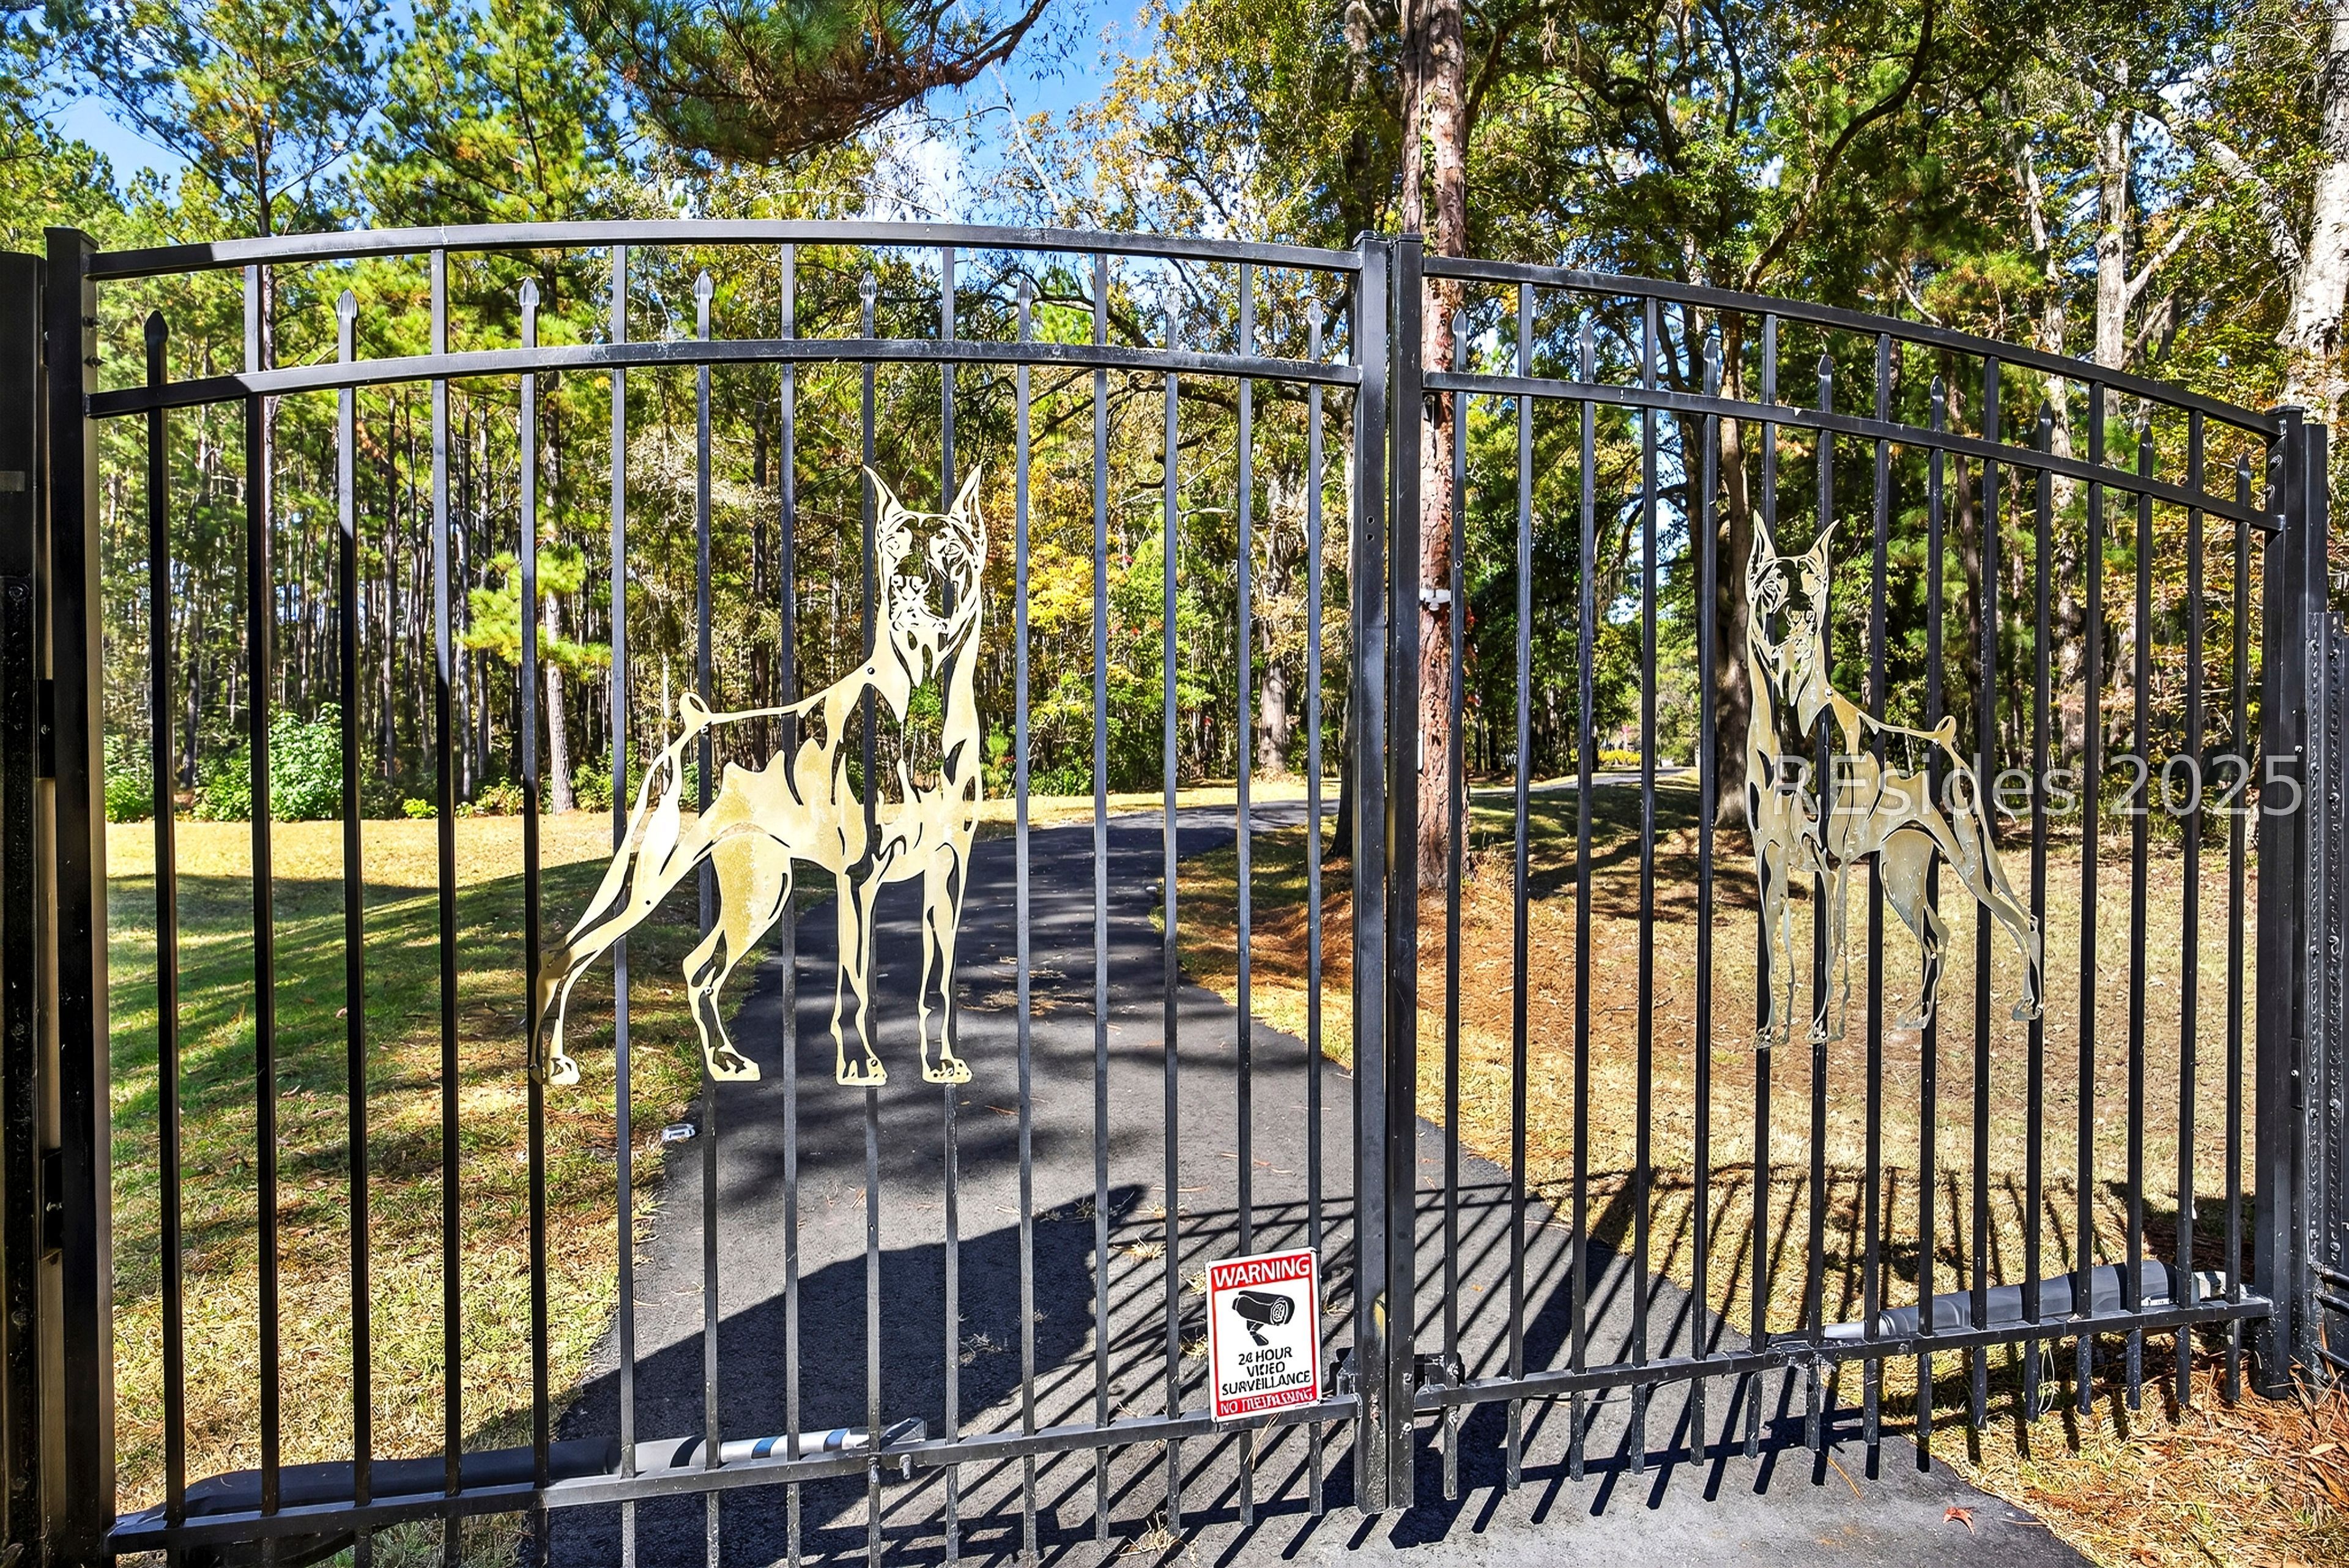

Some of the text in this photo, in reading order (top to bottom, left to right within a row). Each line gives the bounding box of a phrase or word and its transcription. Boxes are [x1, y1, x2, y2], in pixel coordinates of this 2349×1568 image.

[1214, 1256, 1310, 1288] WARNING
[1255, 1346, 1293, 1362] HOUR
[1222, 1370, 1312, 1395] SURVEILLANCE
[1220, 1401, 1238, 1415] NO
